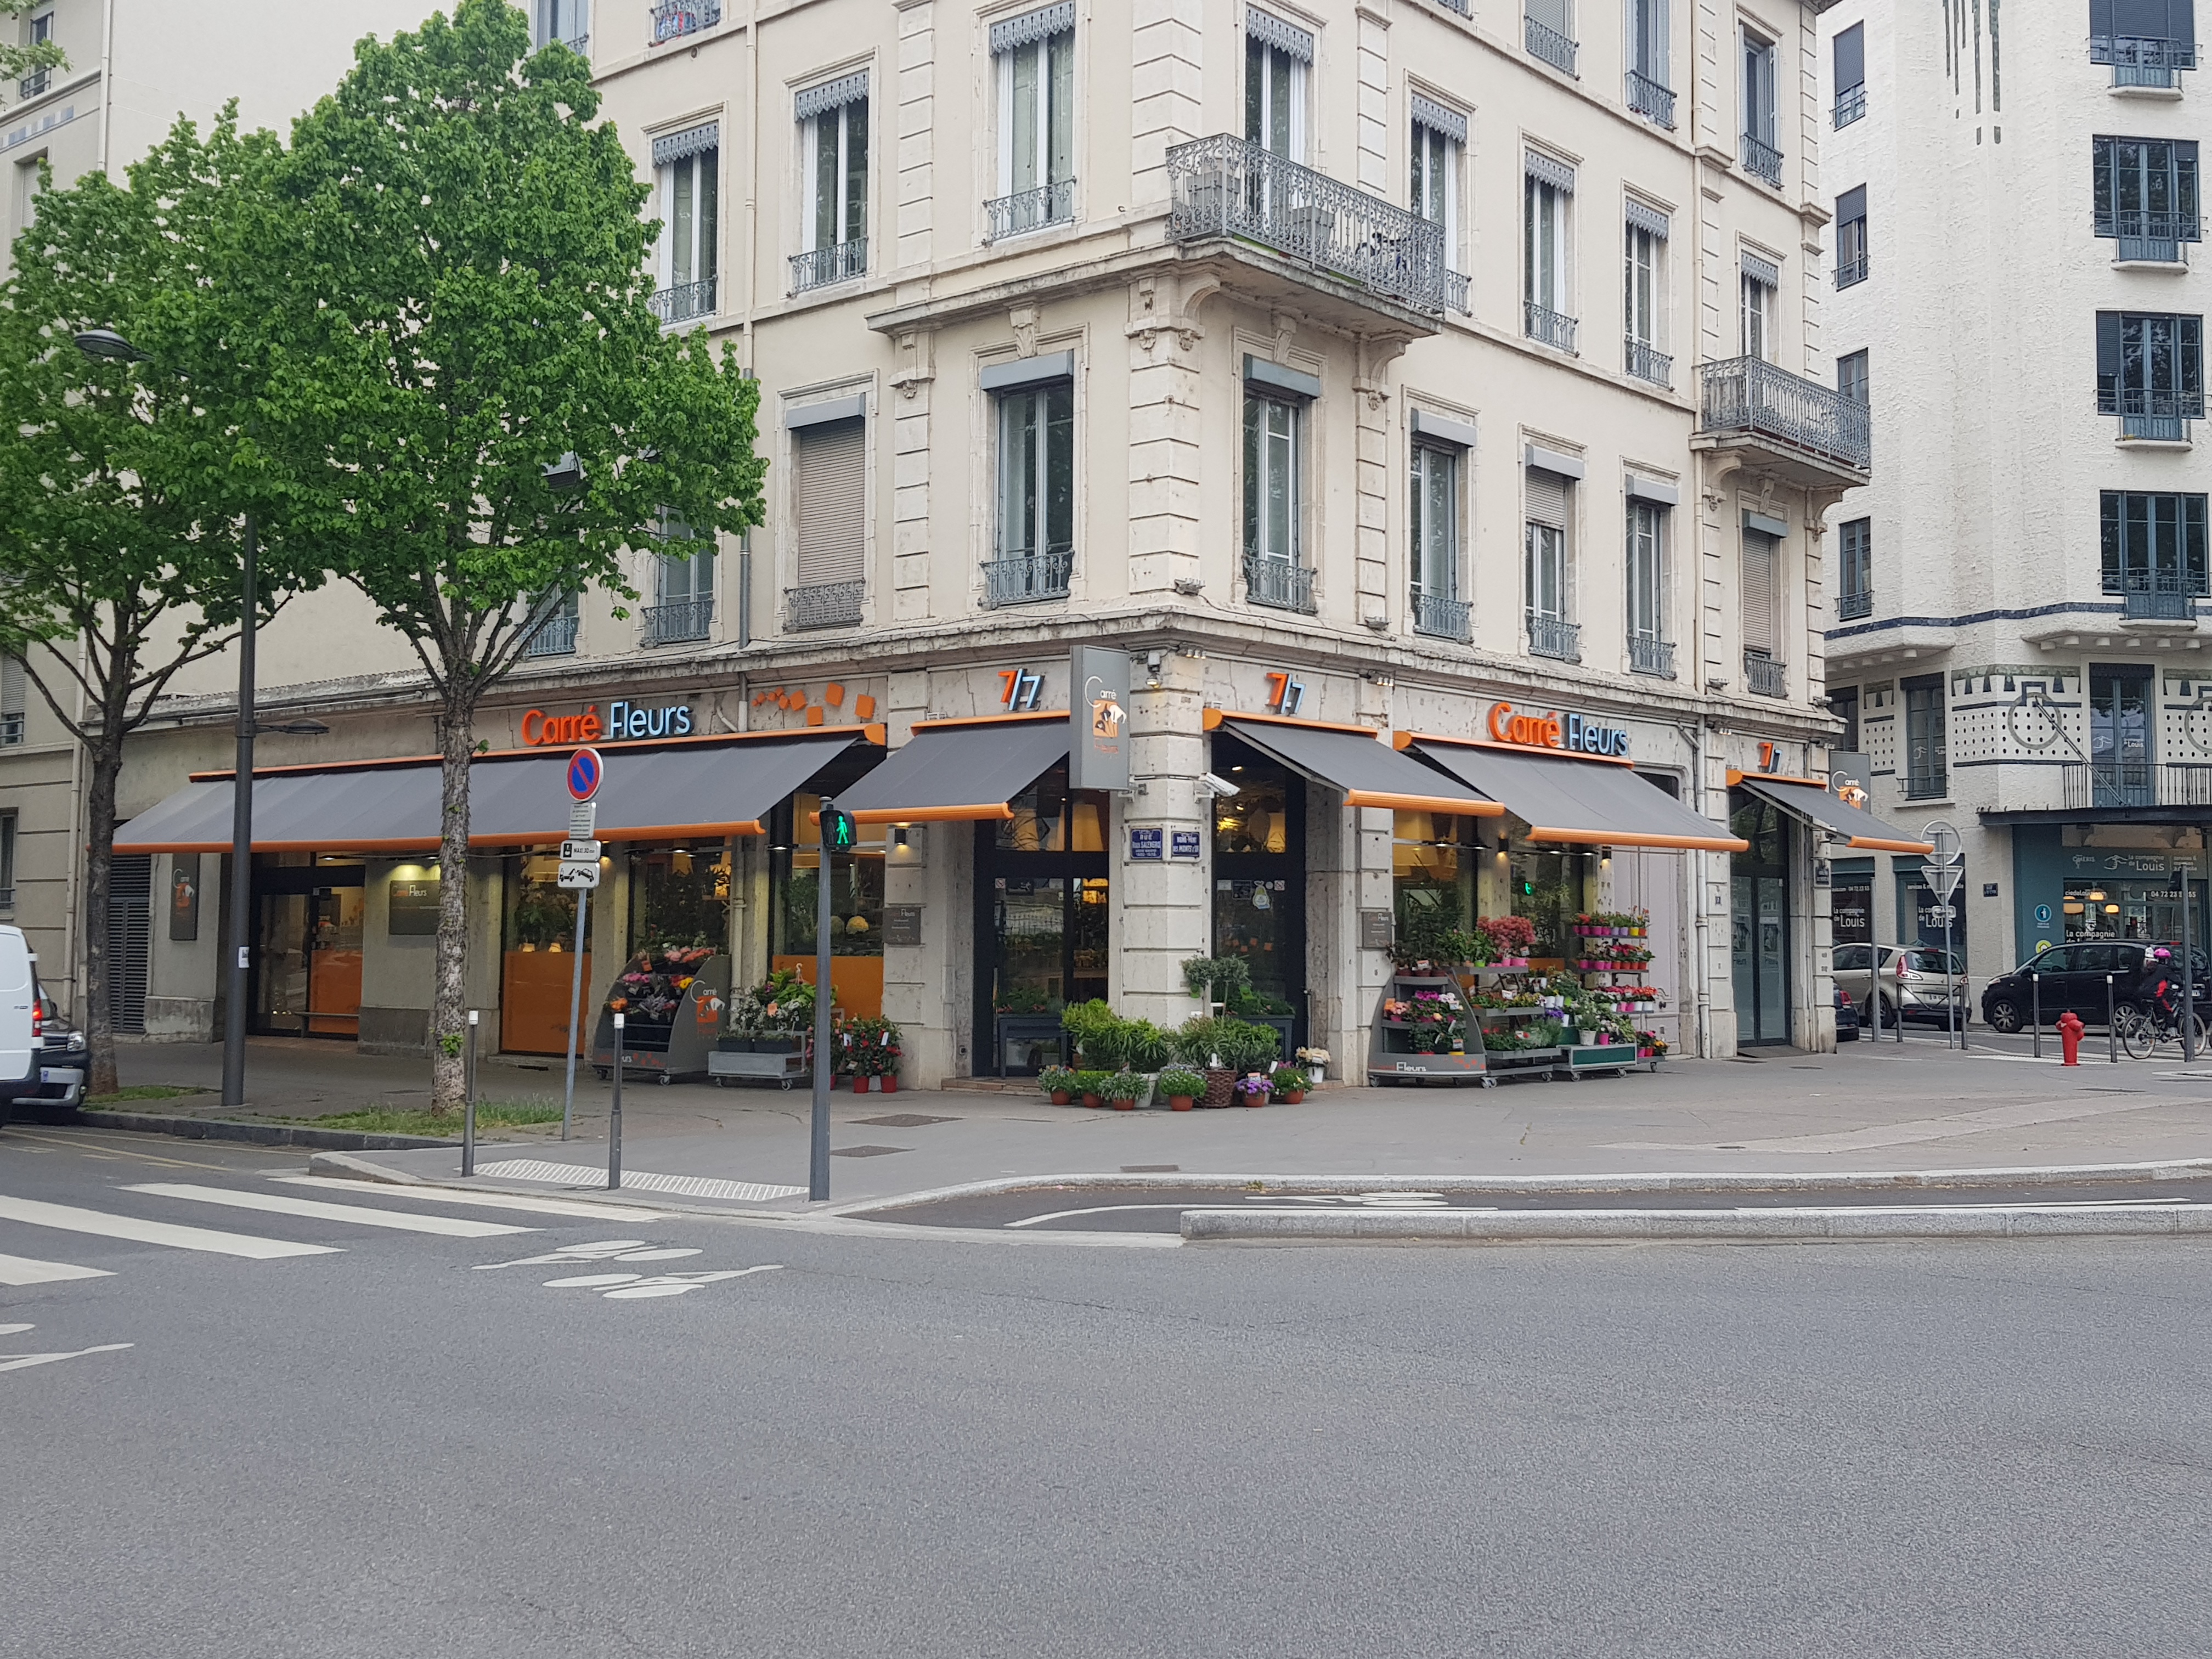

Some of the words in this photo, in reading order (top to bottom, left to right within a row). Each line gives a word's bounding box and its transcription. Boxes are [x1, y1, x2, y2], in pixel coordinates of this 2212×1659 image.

[998, 668, 1045, 710] 7/7
[1085, 676, 1117, 708] Carré
[1266, 673, 1306, 714] 7/7
[522, 705, 602, 745] Carré
[610, 701, 692, 738] Fleurs
[1488, 702, 1560, 747] Carré
[1565, 713, 1628, 755] Fleurs
[2136, 860, 2165, 871] Louis
[409, 884, 427, 896] Fleurs
[1841, 914, 1865, 927] Louis
[1926, 914, 1953, 928] Lous
[2075, 930, 2115, 939] compagnie
[690, 980, 717, 1003] Carré
[1396, 1062, 1426, 1071] Fleurs
